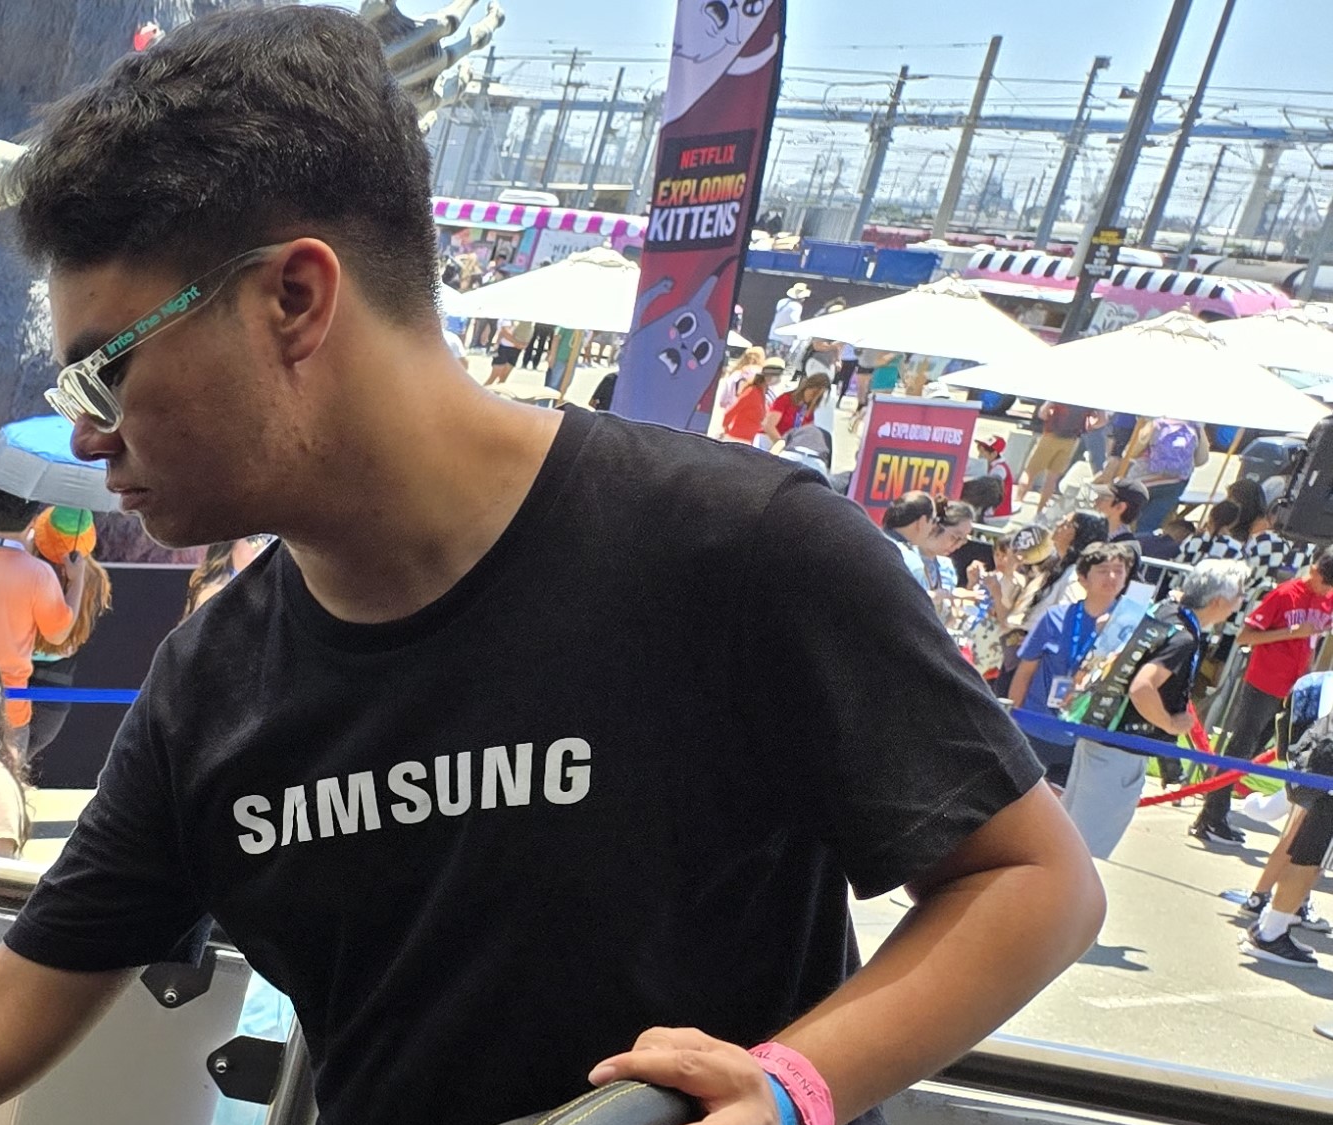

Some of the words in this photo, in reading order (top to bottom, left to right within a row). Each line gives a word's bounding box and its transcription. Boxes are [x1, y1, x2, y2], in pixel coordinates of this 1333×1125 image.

[680, 143, 737, 170] NETFLIX
[656, 173, 747, 207] EXPLODING
[647, 201, 741, 242] KITTENS
[135, 314, 162, 335] the
[160, 285, 202, 319] Night
[890, 422, 932, 443] EXPLODING
[931, 425, 964, 446] KITTENS
[870, 453, 951, 501] ENTER
[232, 737, 592, 856] SAMSUNG
[775, 1056, 817, 1099] EVENT
